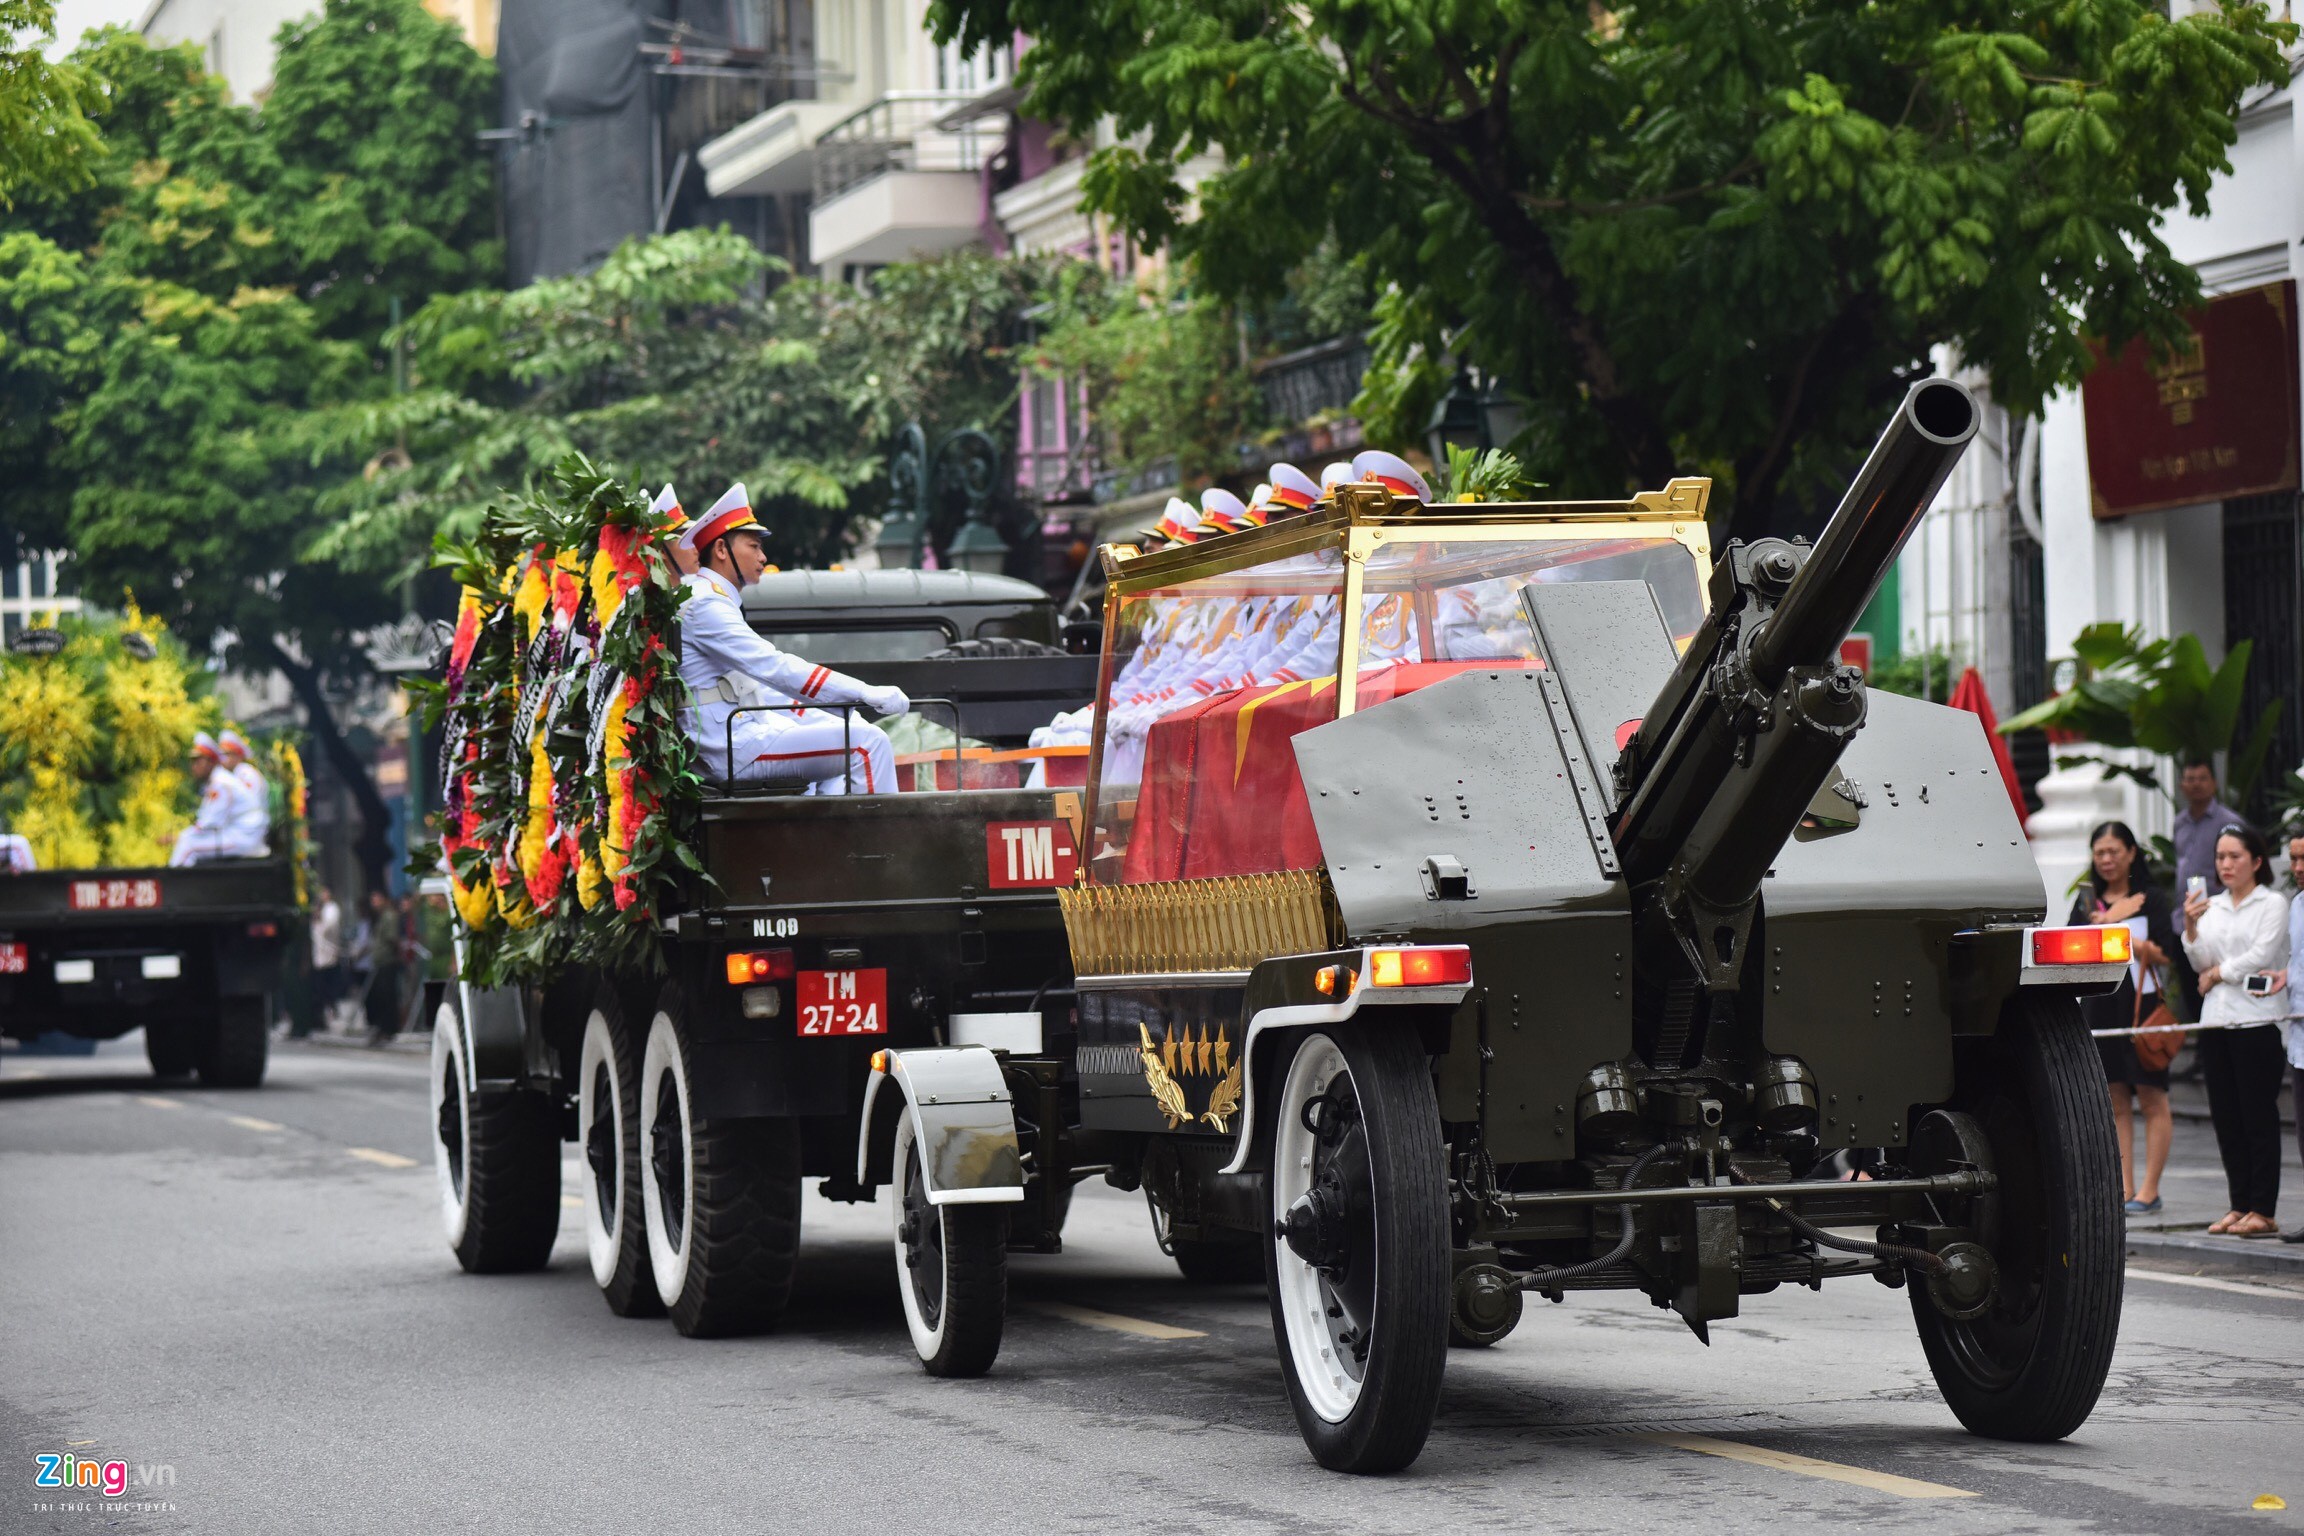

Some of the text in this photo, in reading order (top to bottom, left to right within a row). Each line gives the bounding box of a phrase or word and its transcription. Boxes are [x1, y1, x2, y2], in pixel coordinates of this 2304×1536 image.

[1001, 826, 1071, 881] TM-
[753, 917, 799, 938] NLQĐ
[824, 971, 856, 1000] TM
[802, 1002, 878, 1034] 27-24
